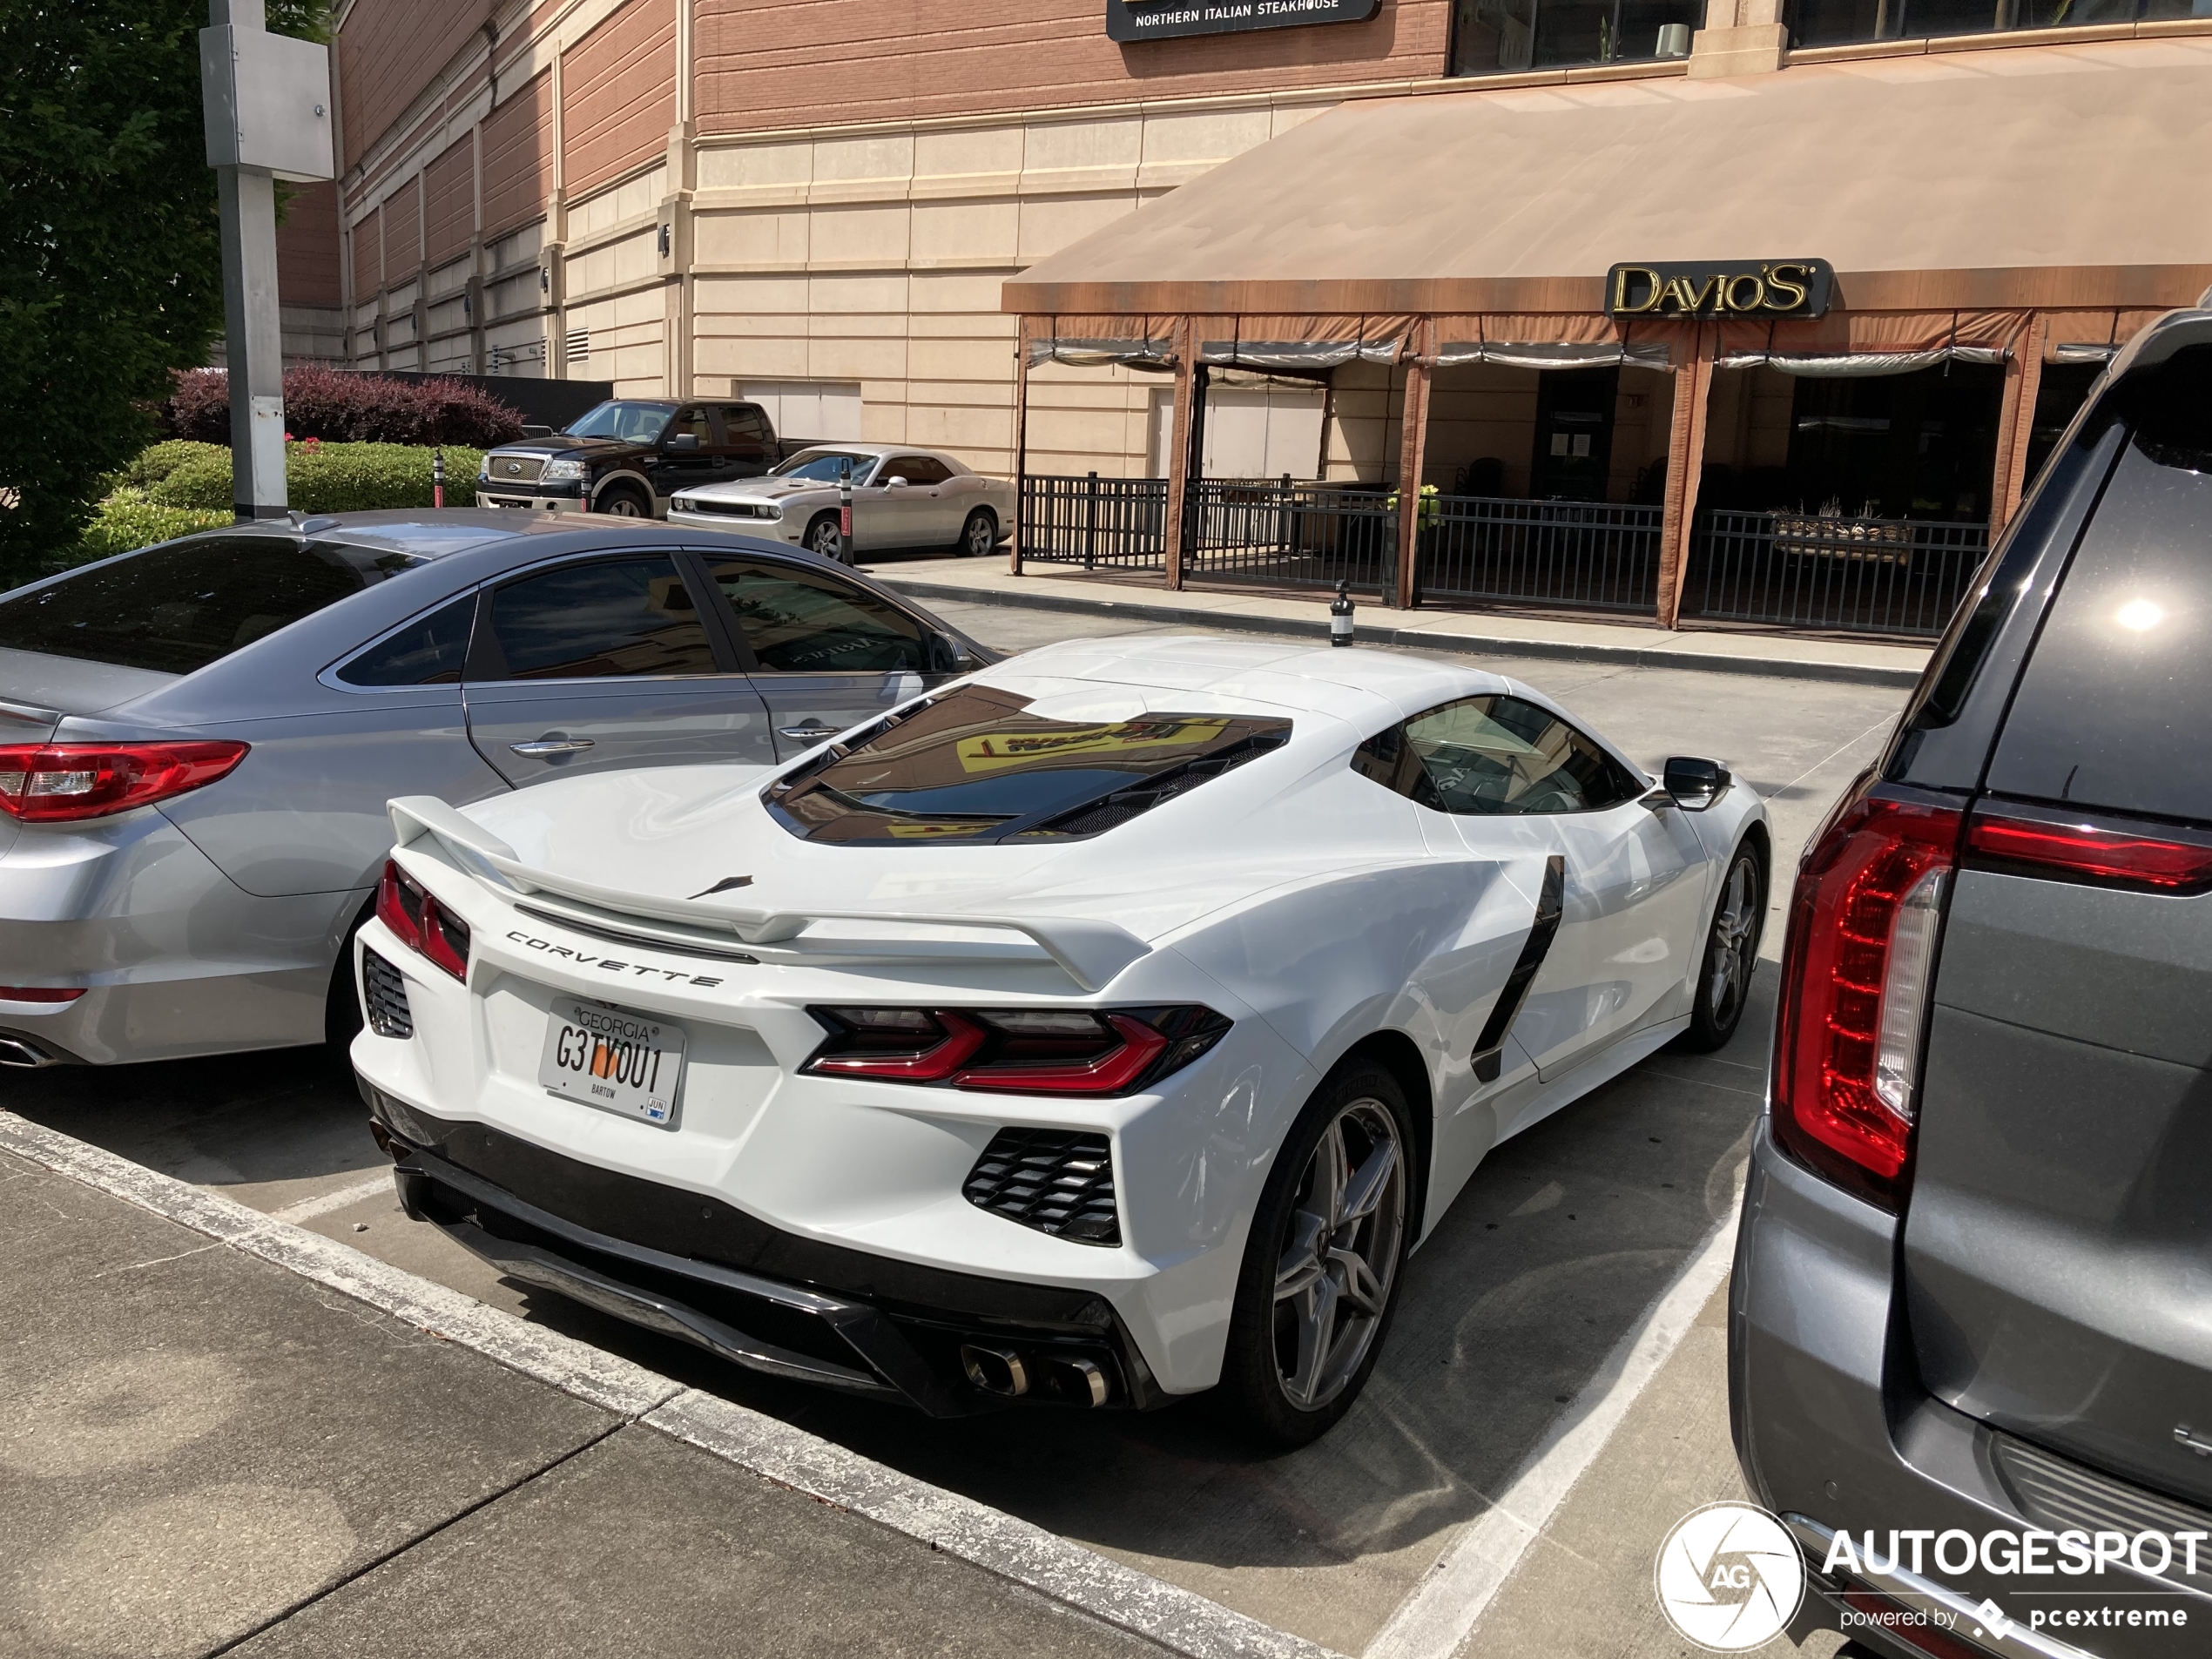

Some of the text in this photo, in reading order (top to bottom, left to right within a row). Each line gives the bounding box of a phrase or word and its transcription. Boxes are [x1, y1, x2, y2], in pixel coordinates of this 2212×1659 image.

[1136, 0, 1339, 27] NORTHERN ITALIAN STEAKHOUSE
[1611, 264, 1808, 311] DAVIO'S
[506, 931, 725, 988] CORVETTE
[578, 1010, 650, 1042] GEORGIA
[591, 1083, 617, 1099] BARTOW
[649, 1099, 664, 1110] JUN
